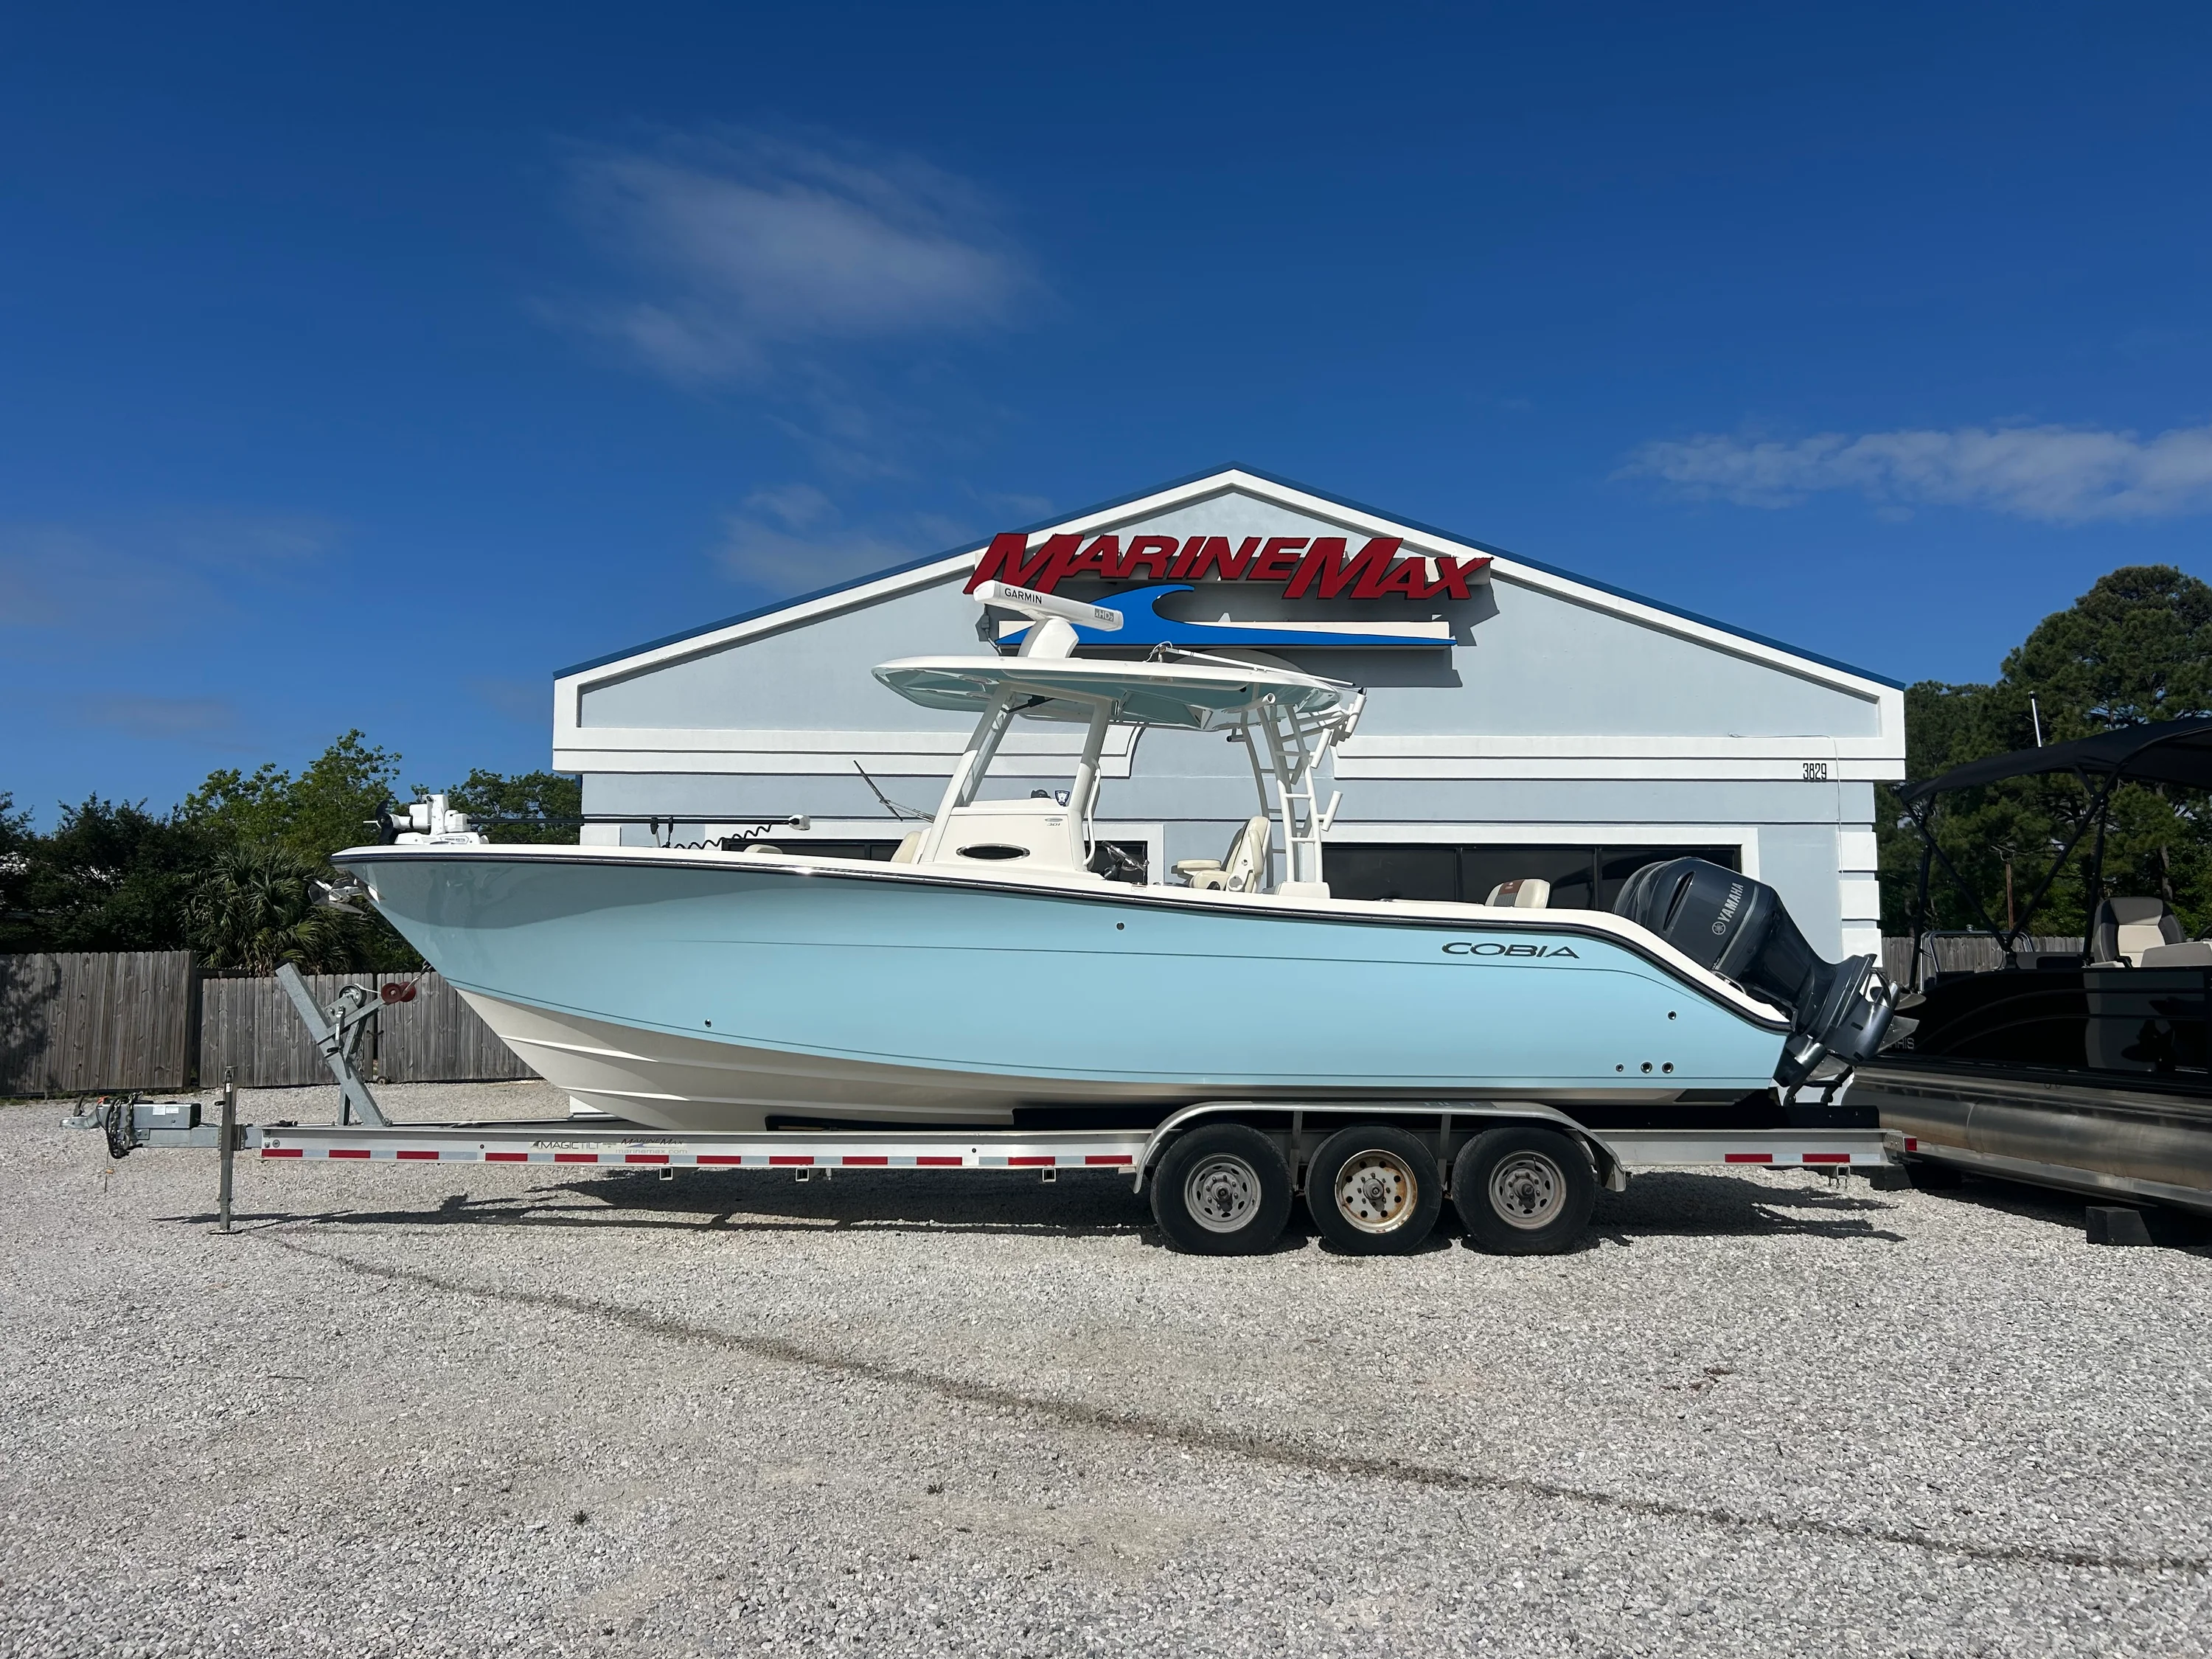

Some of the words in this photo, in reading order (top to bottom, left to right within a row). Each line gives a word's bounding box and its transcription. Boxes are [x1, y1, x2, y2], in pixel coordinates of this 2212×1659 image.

[1004, 588, 1042, 605] GARMIN
[1803, 762, 1827, 782] 3829
[1717, 882, 1744, 922] YAMAHA
[1441, 942, 1580, 959] COBIA
